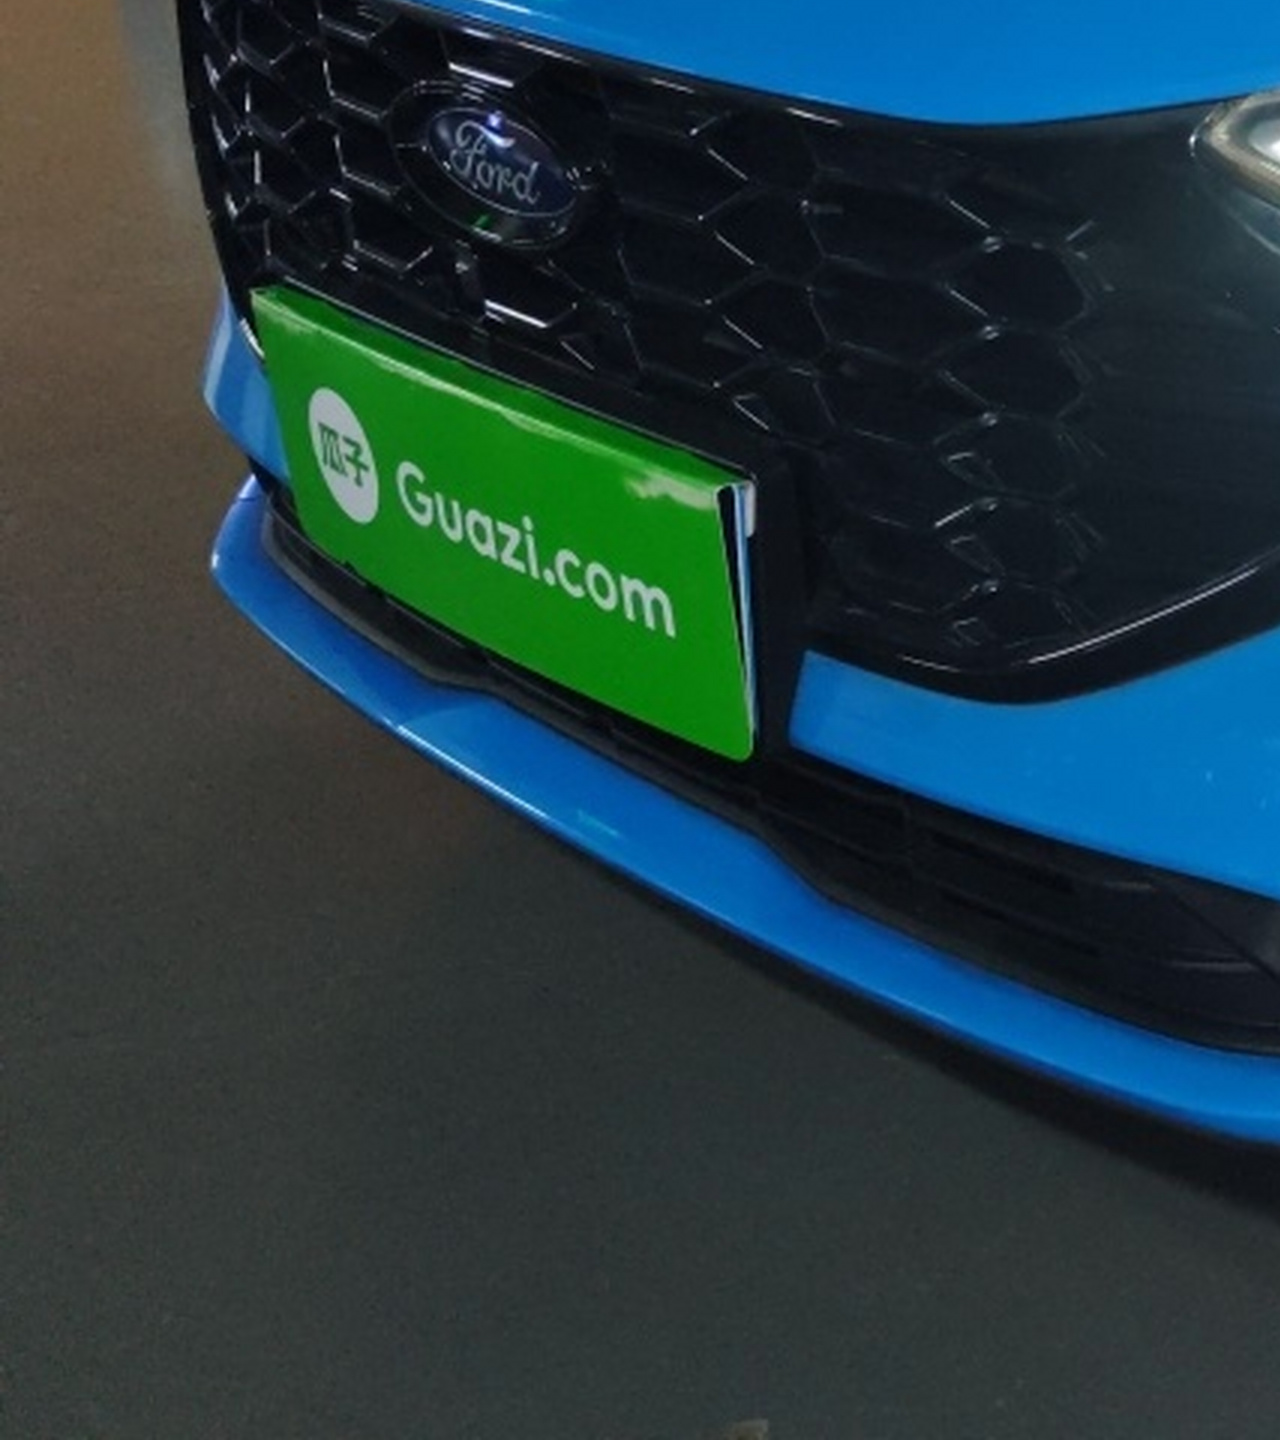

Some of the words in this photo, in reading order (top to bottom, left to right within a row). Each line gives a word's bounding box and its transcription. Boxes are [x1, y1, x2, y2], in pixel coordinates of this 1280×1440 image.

[451, 120, 542, 204] Ford
[318, 422, 369, 488] 瓜子
[396, 461, 676, 639] Guazi.com
